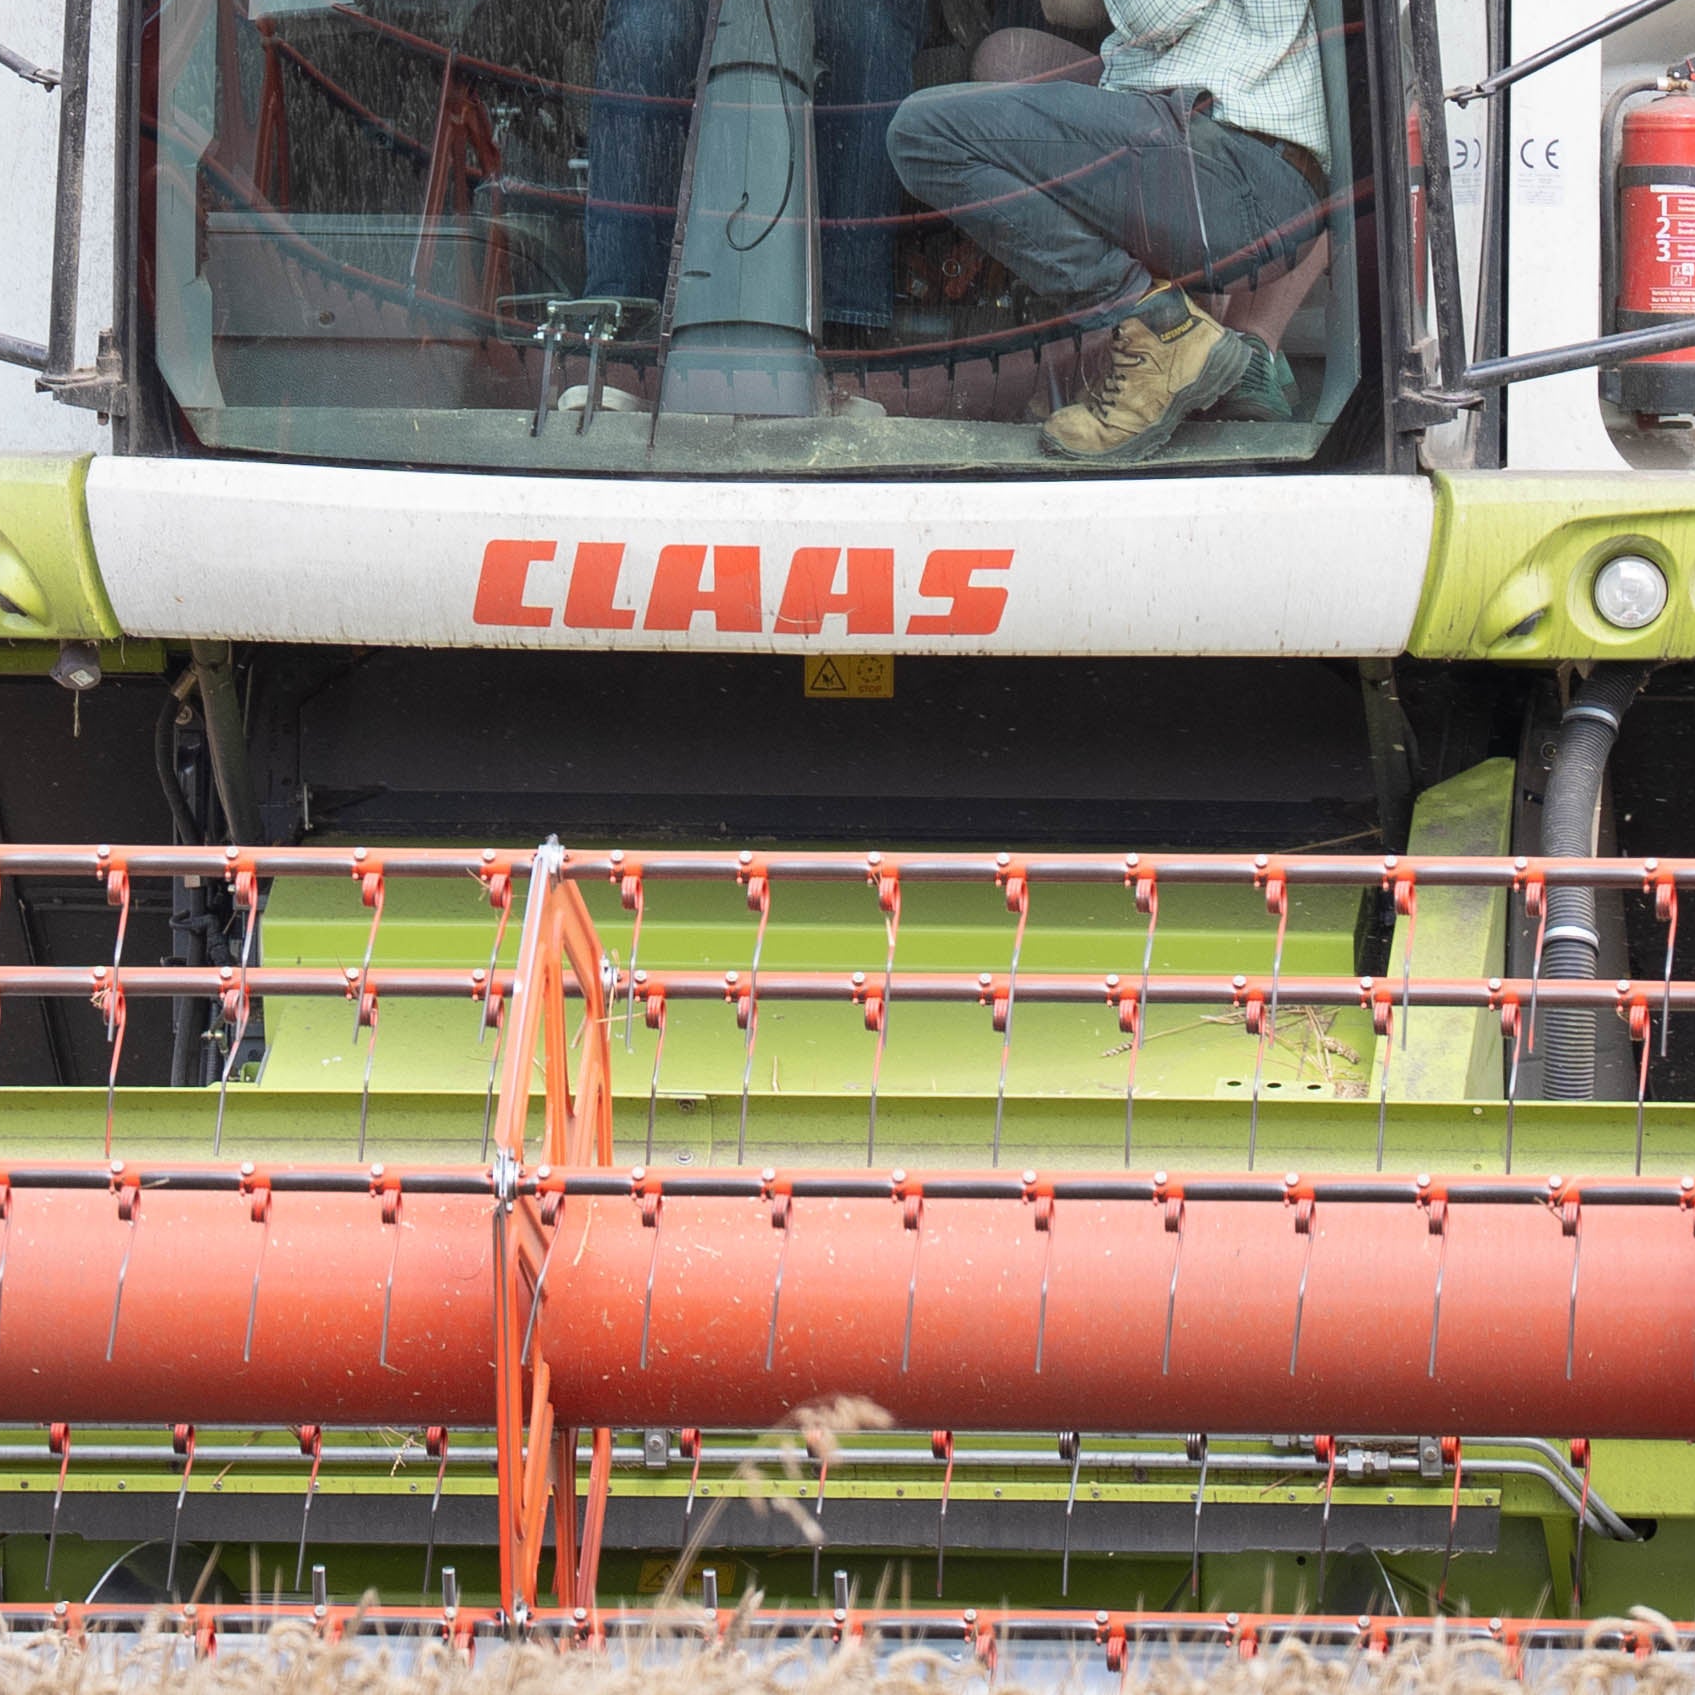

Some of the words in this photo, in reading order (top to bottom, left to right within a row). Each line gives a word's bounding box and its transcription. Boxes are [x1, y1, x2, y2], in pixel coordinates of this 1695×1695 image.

[1520, 138, 1560, 170] CE
[1657, 194, 1668, 216] 1
[1655, 216, 1671, 239] 2
[1655, 239, 1671, 262] 3
[473, 539, 1015, 636] CLAAS
